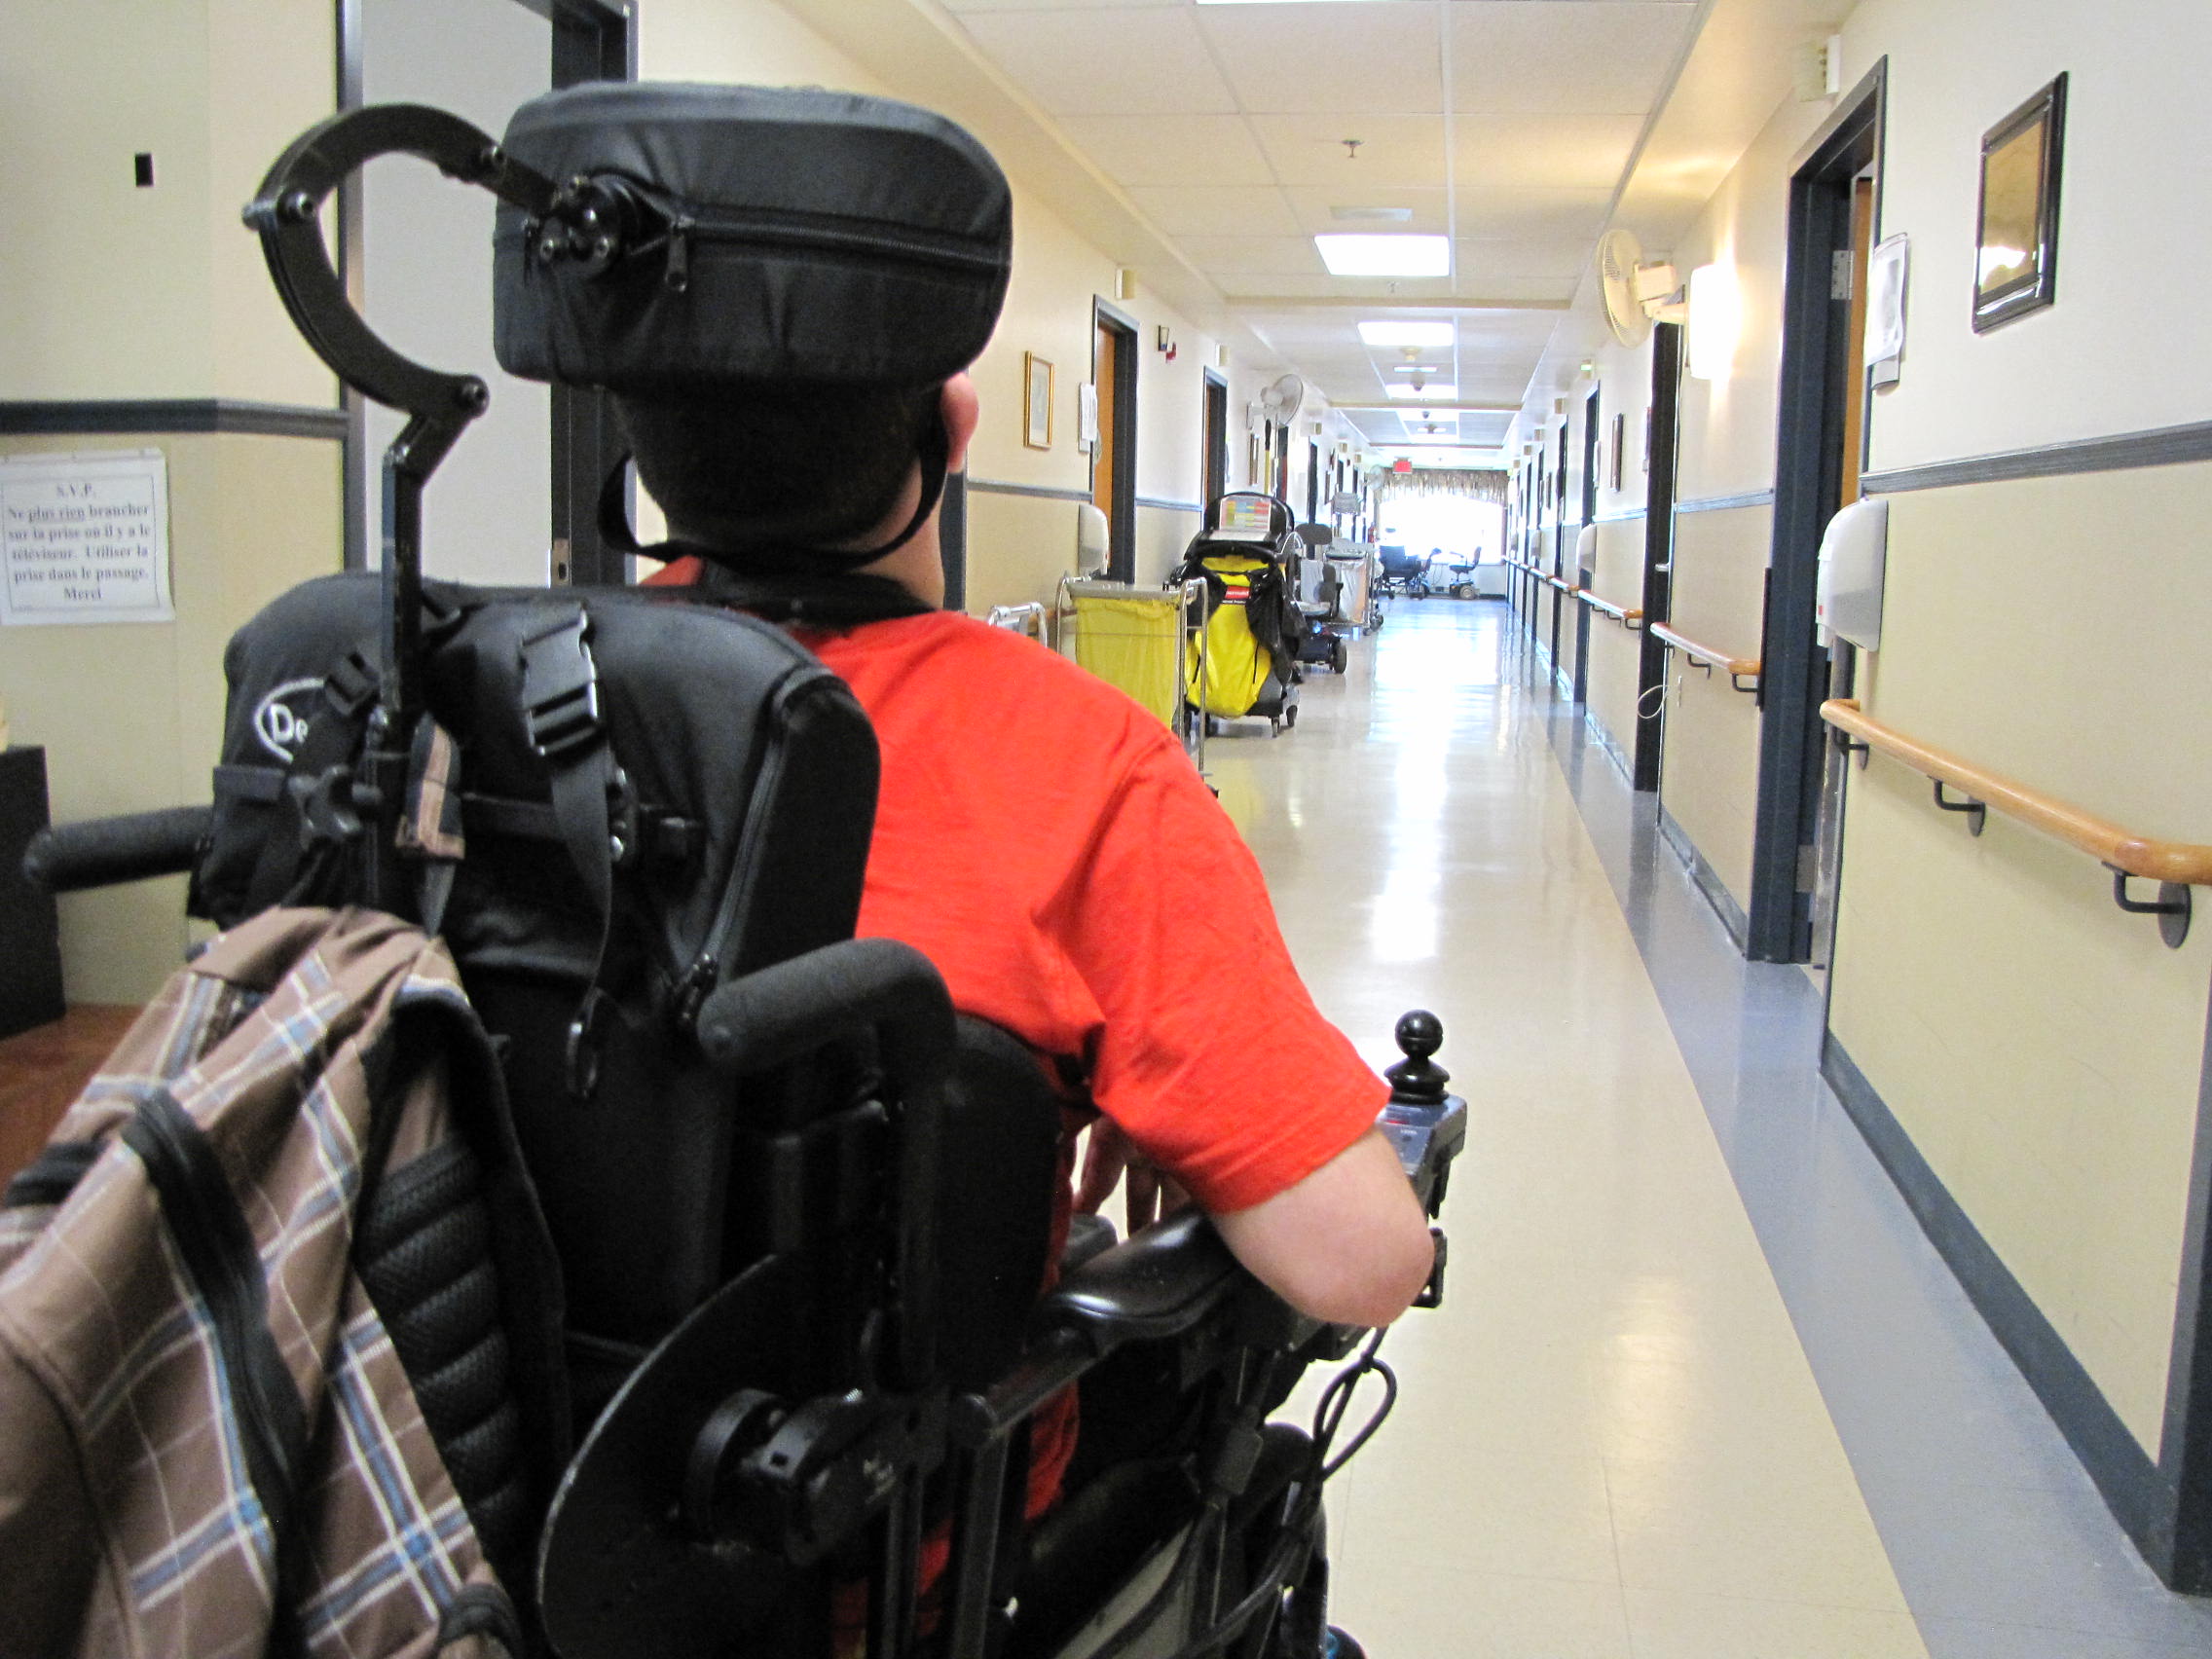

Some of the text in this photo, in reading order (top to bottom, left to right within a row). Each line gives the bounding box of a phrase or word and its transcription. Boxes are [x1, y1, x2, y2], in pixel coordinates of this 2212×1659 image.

[9, 502, 149, 523] Ne plus rien brancher
[9, 532, 27, 540] sur
[33, 527, 45, 539] la
[49, 528, 80, 542] prise
[104, 524, 113, 536] il
[140, 523, 150, 535] le
[86, 544, 131, 558] Utiliser
[137, 544, 148, 557] la
[15, 566, 148, 584] prise dans le passage.
[63, 586, 102, 601] Merci
